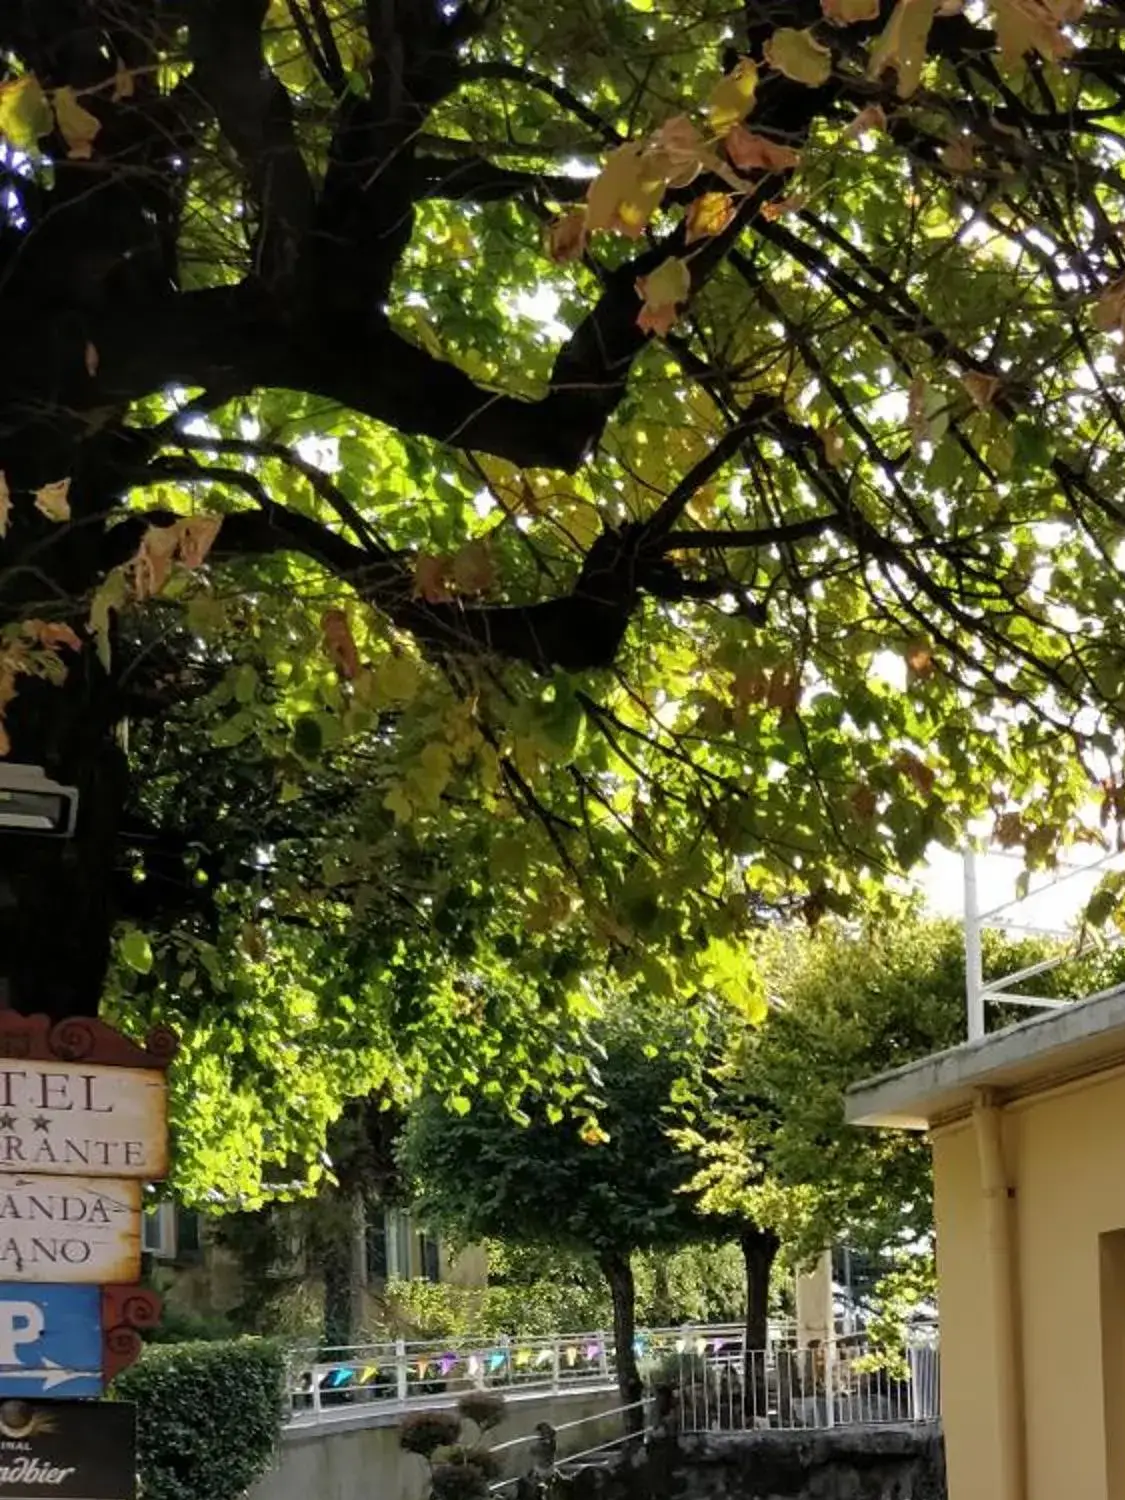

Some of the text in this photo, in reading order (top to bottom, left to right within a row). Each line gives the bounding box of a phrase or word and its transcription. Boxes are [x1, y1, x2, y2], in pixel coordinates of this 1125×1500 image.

[2, 1135, 147, 1167] RANTE
[0, 1194, 112, 1223] ANDA
[0, 1300, 45, 1365] P
